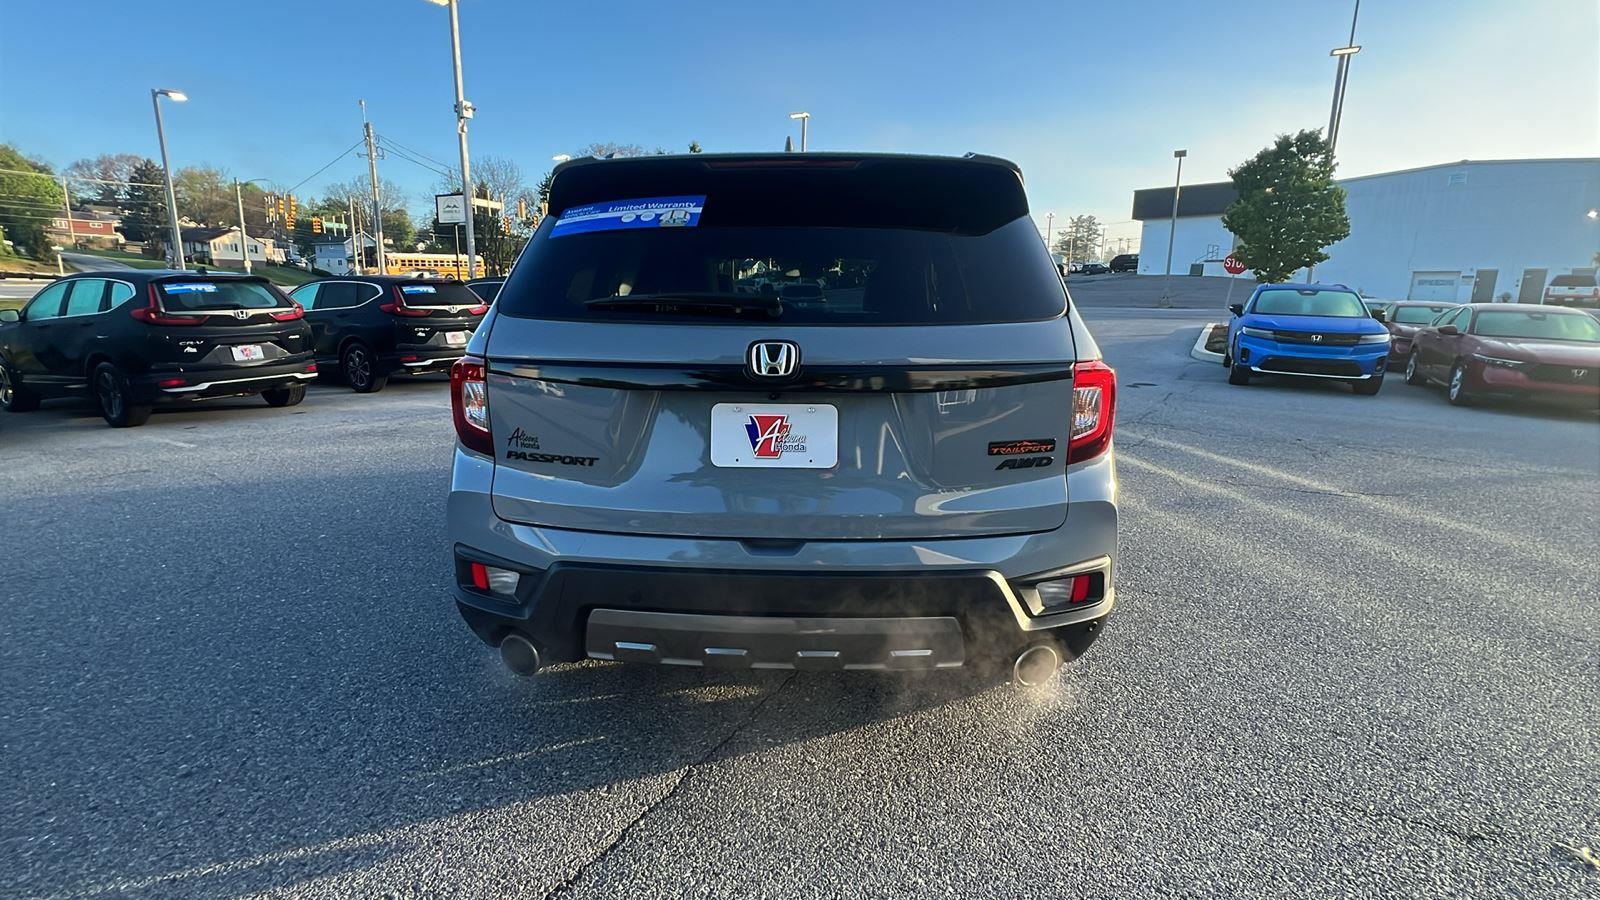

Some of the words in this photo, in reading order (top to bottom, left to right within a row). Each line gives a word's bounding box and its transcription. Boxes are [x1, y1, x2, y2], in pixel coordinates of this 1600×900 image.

[608, 203, 646, 213] Limited
[647, 201, 697, 209] Warranty
[1225, 258, 1245, 268] STO
[776, 443, 806, 452] Honda
[991, 445, 1054, 454] TRAILSPORT
[506, 450, 600, 466] PASSPORT
[995, 457, 1054, 470] AWD
